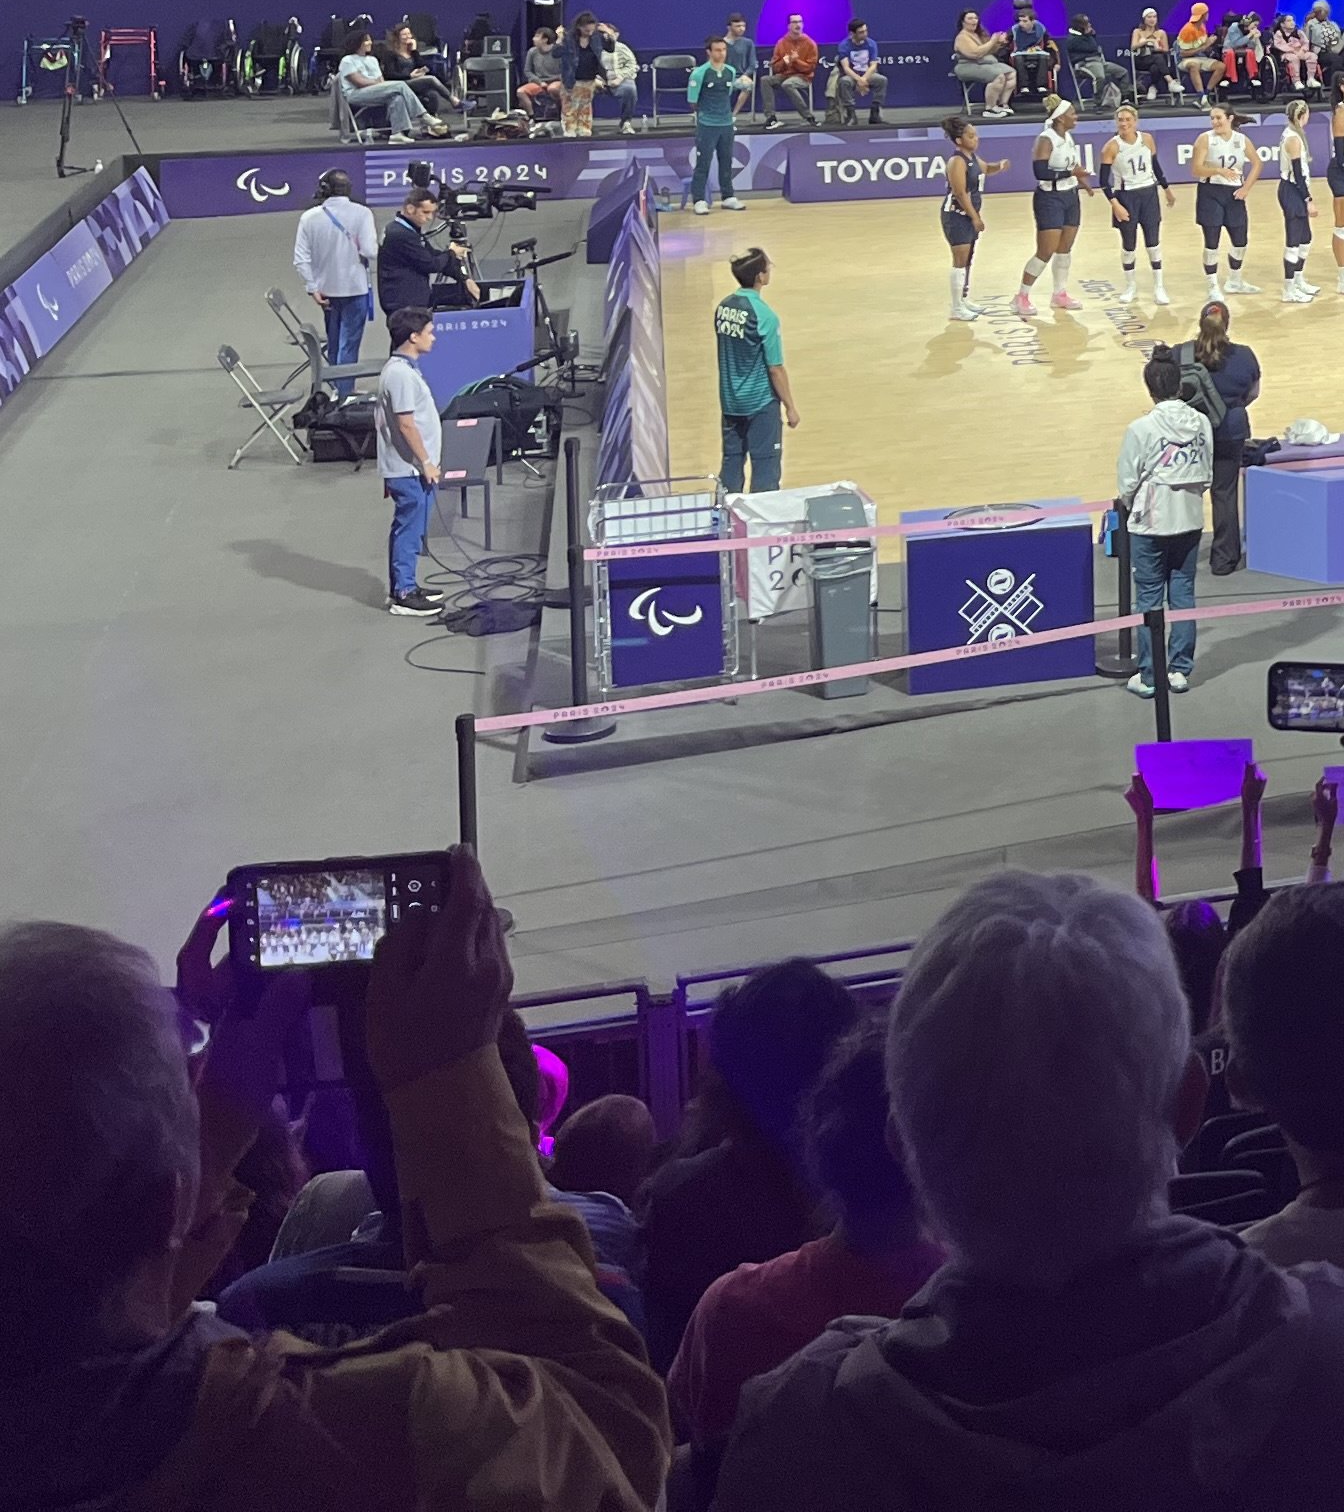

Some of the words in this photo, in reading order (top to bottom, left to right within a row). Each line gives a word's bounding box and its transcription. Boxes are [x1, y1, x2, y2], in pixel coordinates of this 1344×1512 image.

[897, 56, 931, 65] 2024
[816, 155, 948, 184] TOYOTA
[1127, 157, 1147, 175] 14
[1218, 155, 1237, 171] 12
[475, 163, 548, 183] 2024
[717, 305, 749, 325] PARIS
[471, 319, 508, 330] 2024
[716, 319, 745, 339] 2024
[776, 535, 807, 544] PARIS
[596, 549, 628, 559] PARIS
[1282, 597, 1311, 607] PARIS
[1314, 594, 1342, 605] 2024
[955, 644, 990, 655] PARIS
[991, 639, 1022, 651] 2024
[762, 677, 796, 688] PARIS
[553, 707, 590, 719] PARIS
[591, 702, 626, 714] 2024
